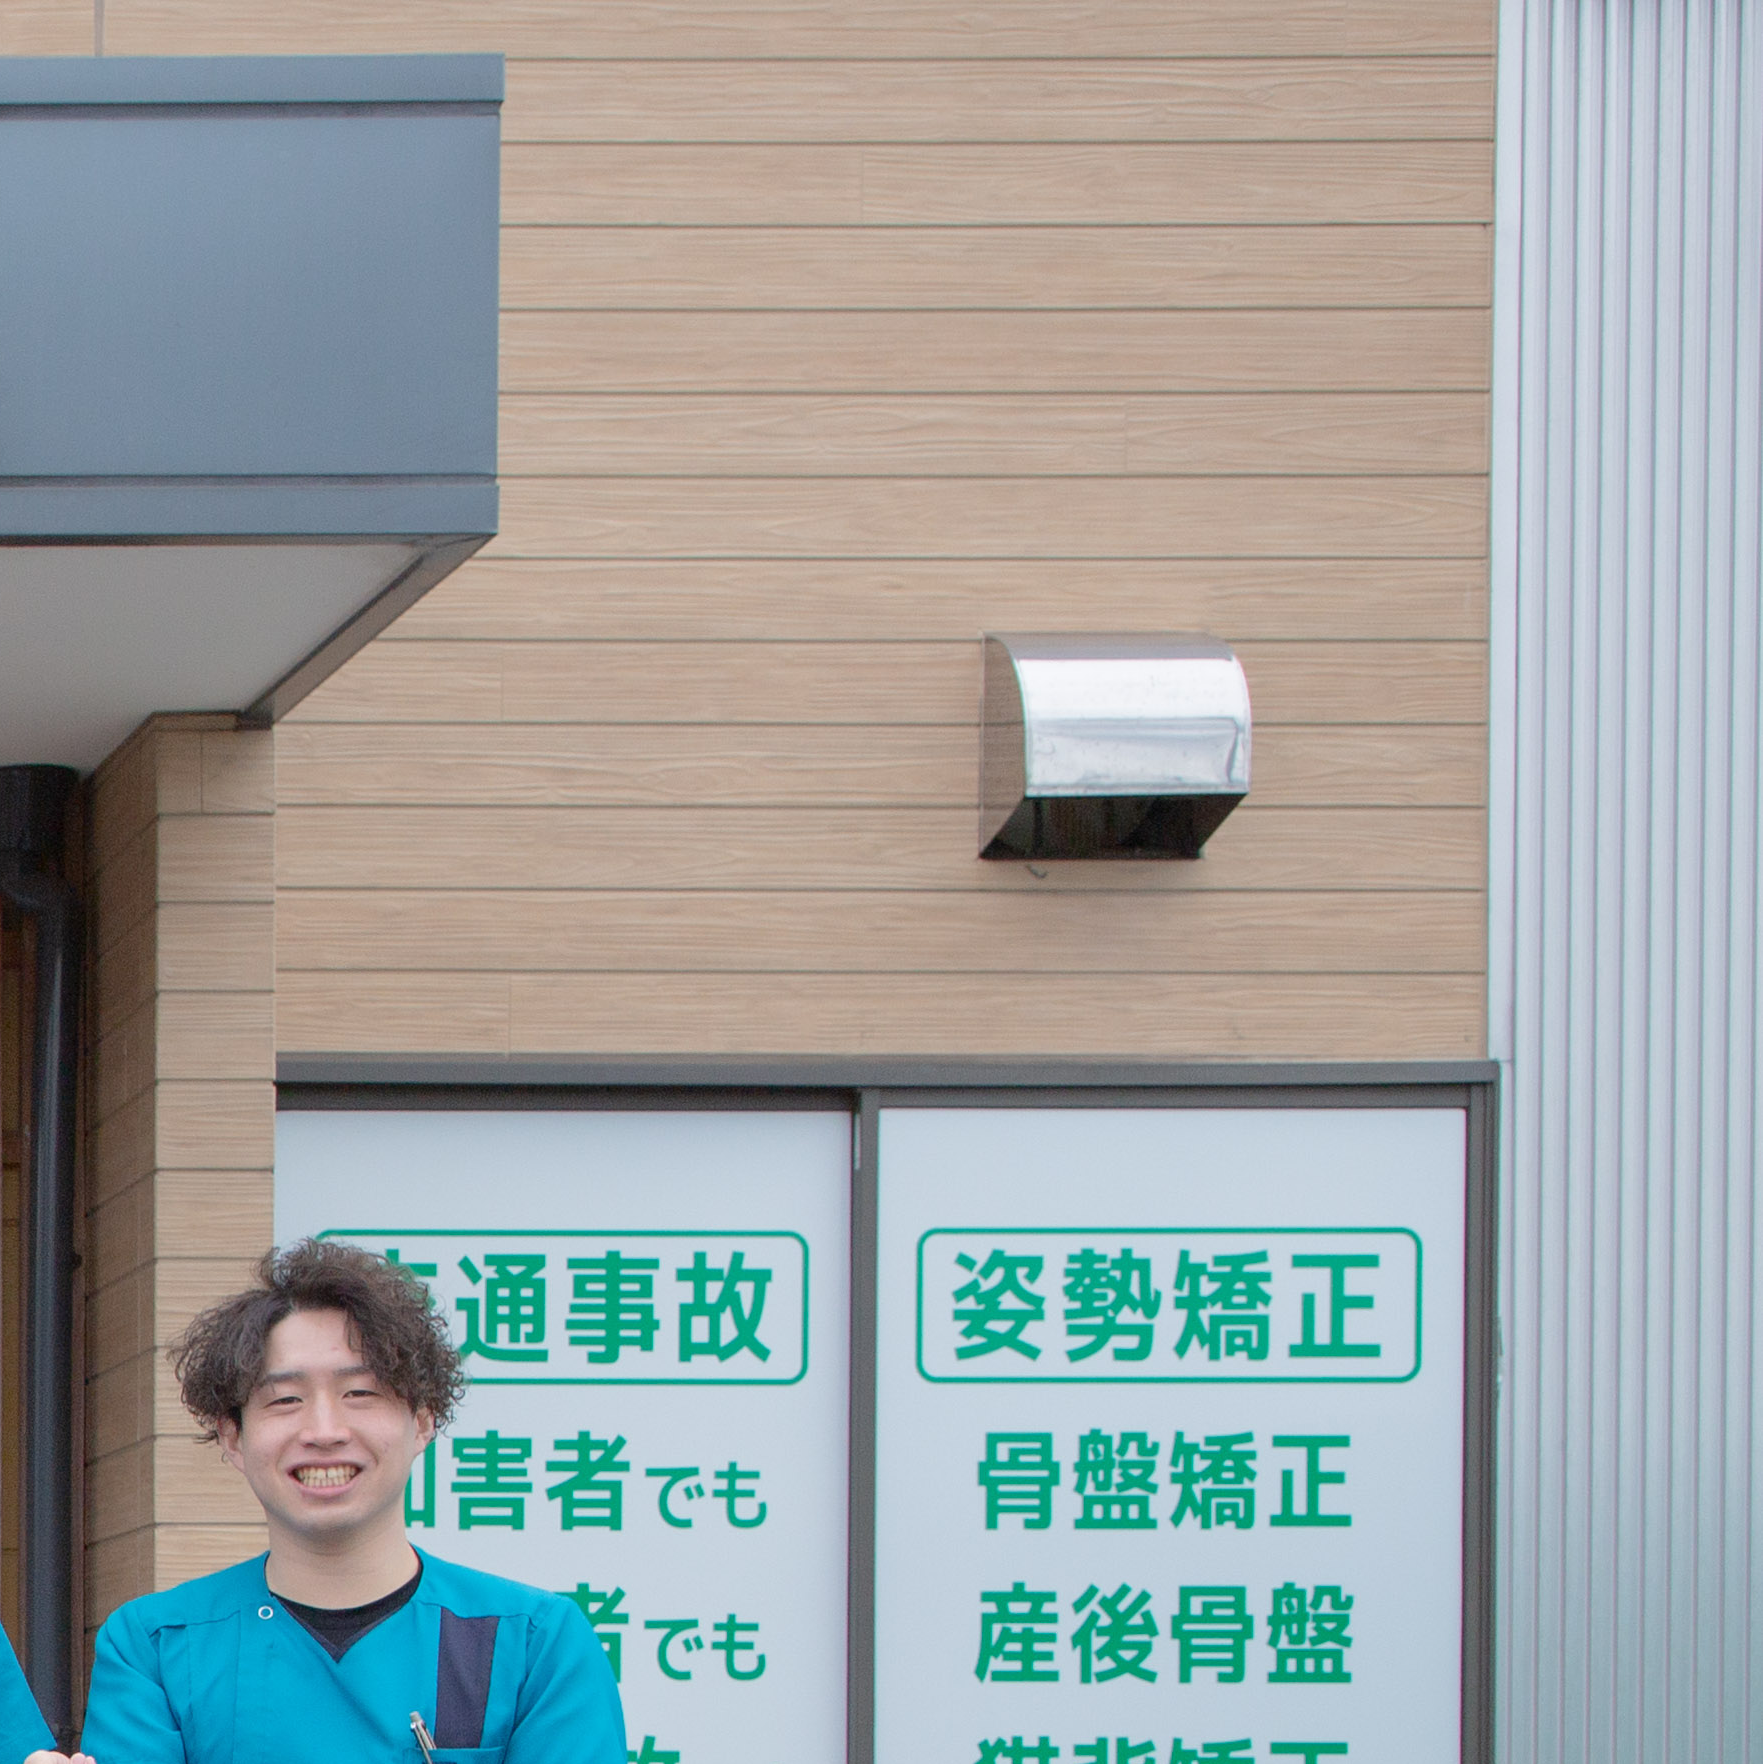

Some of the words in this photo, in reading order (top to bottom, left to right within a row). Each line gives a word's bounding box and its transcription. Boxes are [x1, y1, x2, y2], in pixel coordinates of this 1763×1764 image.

[953, 1247, 1382, 1363] 姿勢矯正
[978, 1428, 1353, 1530] 骨盤矯正
[974, 1581, 1354, 1684] 産後骨盤
